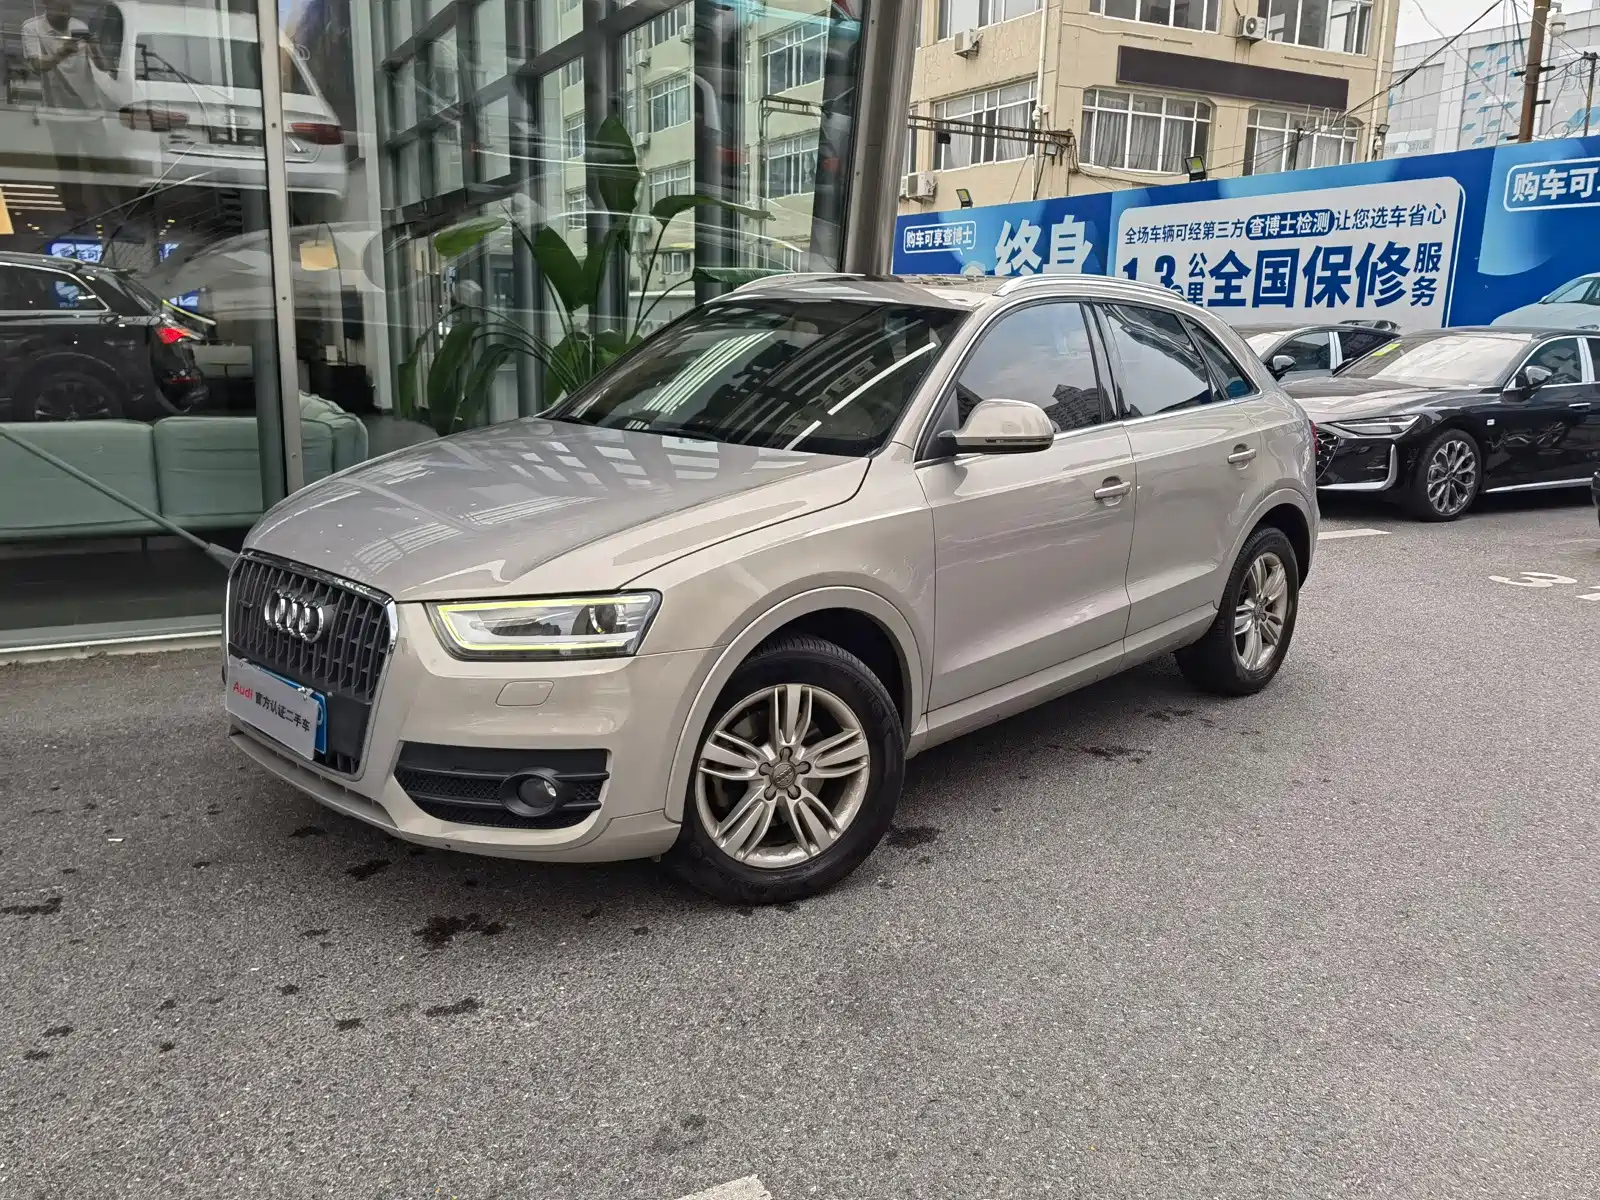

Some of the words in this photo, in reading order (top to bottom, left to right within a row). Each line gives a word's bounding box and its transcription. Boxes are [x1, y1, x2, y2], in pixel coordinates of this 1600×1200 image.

[1511, 166, 1600, 202] 购车可
[906, 225, 973, 248] 购车可享查博士
[994, 214, 1093, 276] 终身
[233, 681, 253, 699] Audi
[256, 692, 310, 732] 官方认证二手车
